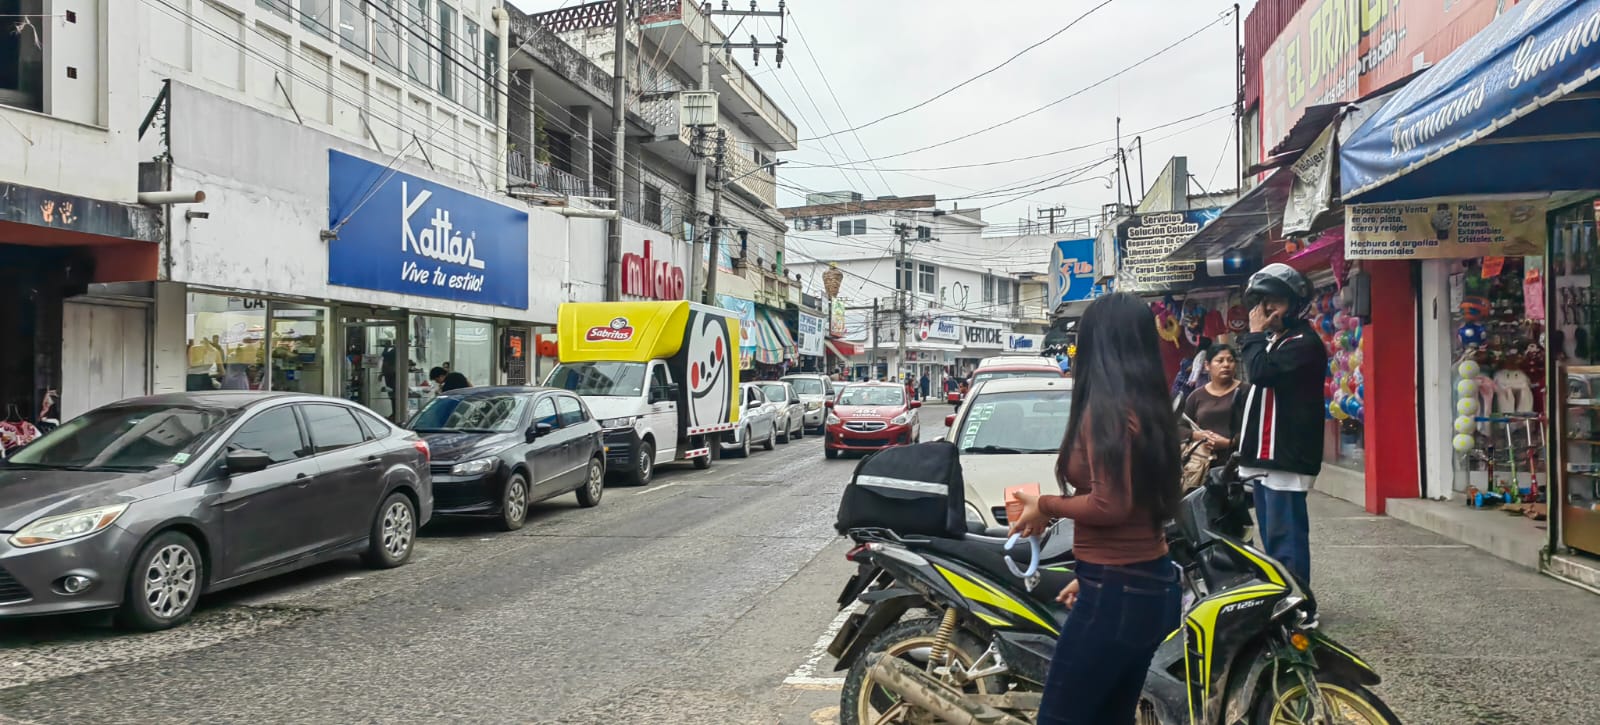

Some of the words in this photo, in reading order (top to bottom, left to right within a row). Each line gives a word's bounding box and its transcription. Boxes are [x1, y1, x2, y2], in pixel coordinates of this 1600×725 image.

[1351, 206, 1397, 216] Reparación
[1399, 207, 1404, 215] y
[1404, 206, 1429, 214] Venta
[402, 181, 485, 269] Kattás
[1142, 214, 1183, 226] Servicios
[1351, 216, 1361, 224] en
[1128, 226, 1166, 238] Solución
[1166, 223, 1198, 235] Celular
[1351, 225, 1373, 233] acero
[1374, 225, 1380, 234] y
[1381, 224, 1408, 234] relojes
[1126, 238, 1165, 248] Reparación
[1165, 237, 1175, 245] De
[1350, 239, 1388, 248] Hechura
[1389, 239, 1401, 248] de
[1402, 239, 1439, 249] argollas
[1350, 247, 1415, 256] matrimoniales
[622, 239, 684, 300] milano
[1155, 265, 1165, 273] De
[401, 261, 430, 284] Vive
[433, 266, 447, 286] tu
[448, 272, 484, 292] estilo!
[590, 328, 629, 339] Sabritas
[964, 326, 1004, 345] VERTICHE
